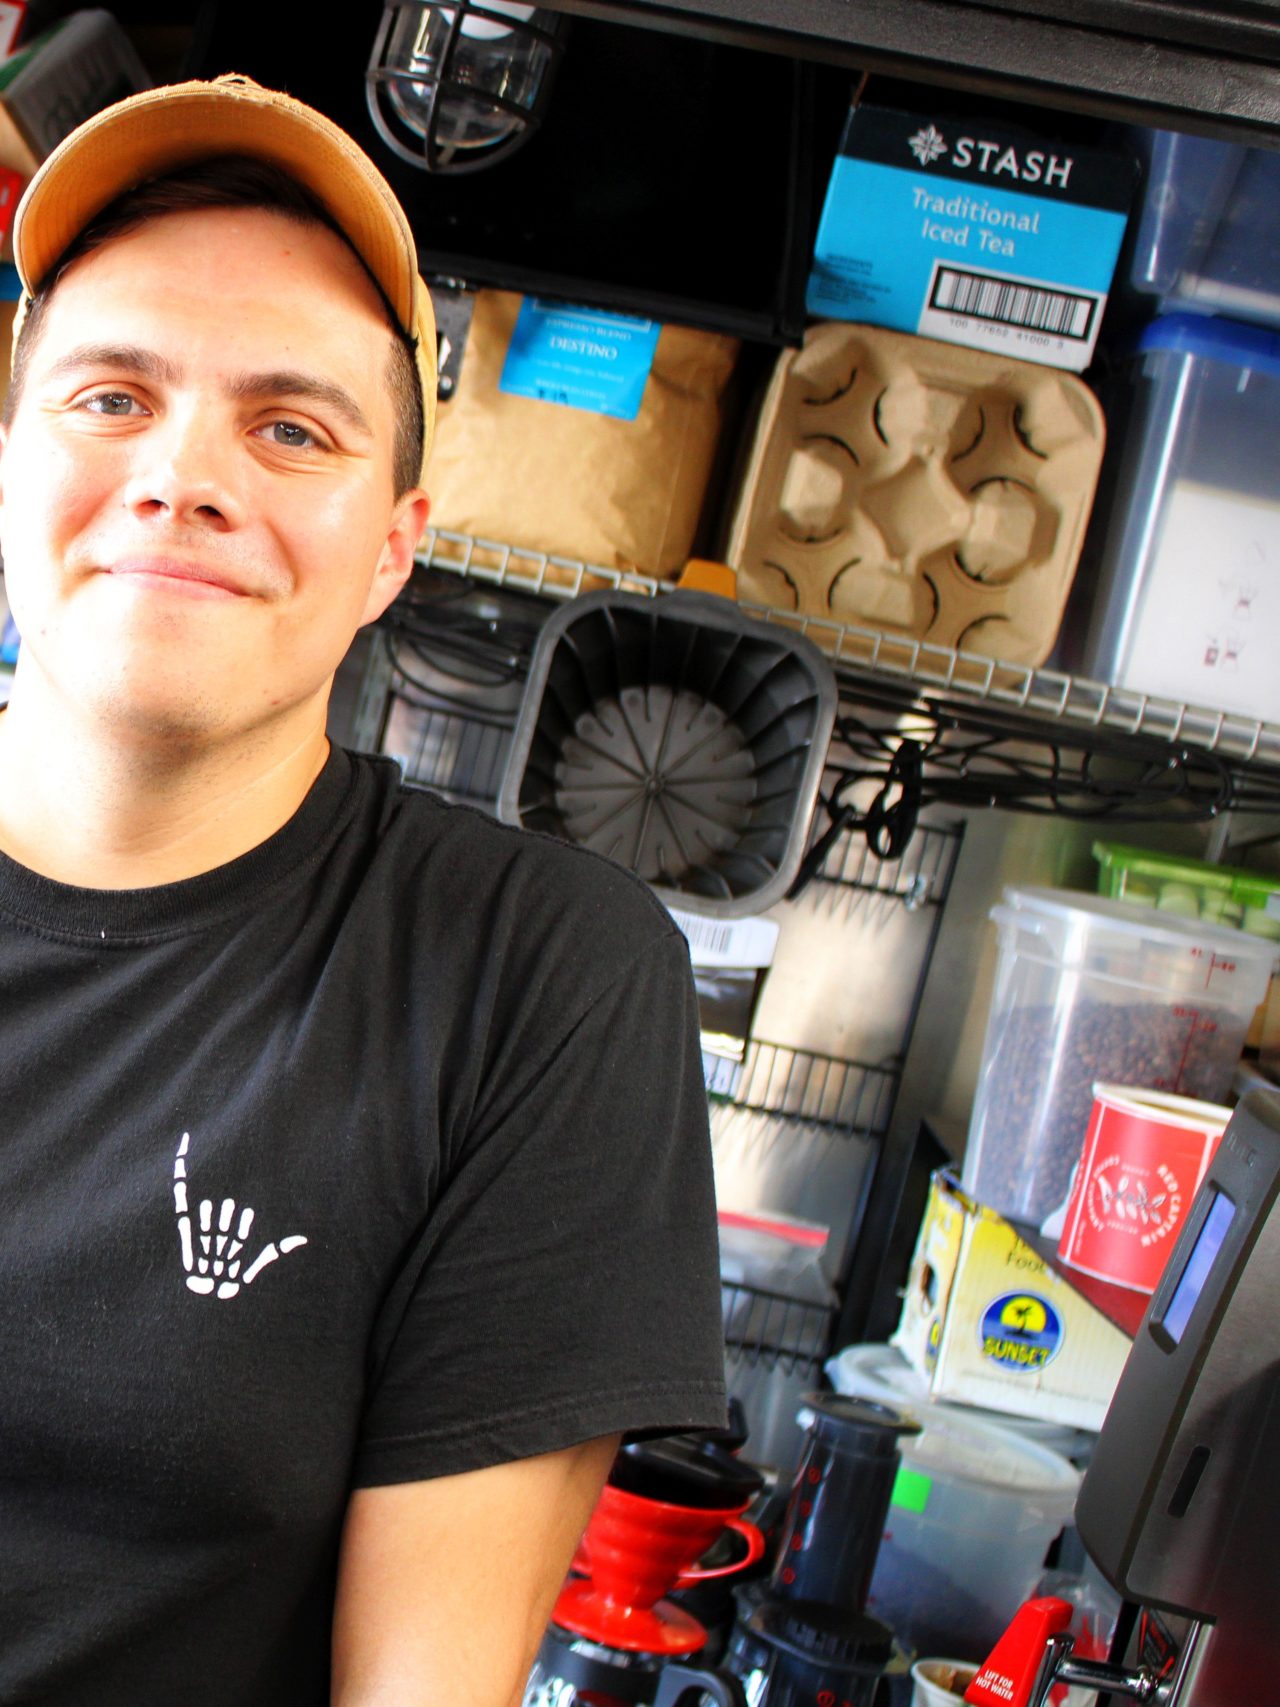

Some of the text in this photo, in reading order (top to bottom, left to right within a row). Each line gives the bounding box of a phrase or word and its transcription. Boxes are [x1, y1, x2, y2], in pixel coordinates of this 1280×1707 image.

[952, 137, 1073, 188] STASH
[913, 186, 1040, 234] Traditional
[922, 218, 1015, 257] Iced Tea
[549, 335, 618, 361] DESTINO
[1156, 1163, 1179, 1193] RED
[982, 1336, 1050, 1367] SUNSET
[975, 1675, 1014, 1701] HOT WATER
[984, 1668, 1014, 1689] LIFT FOR
